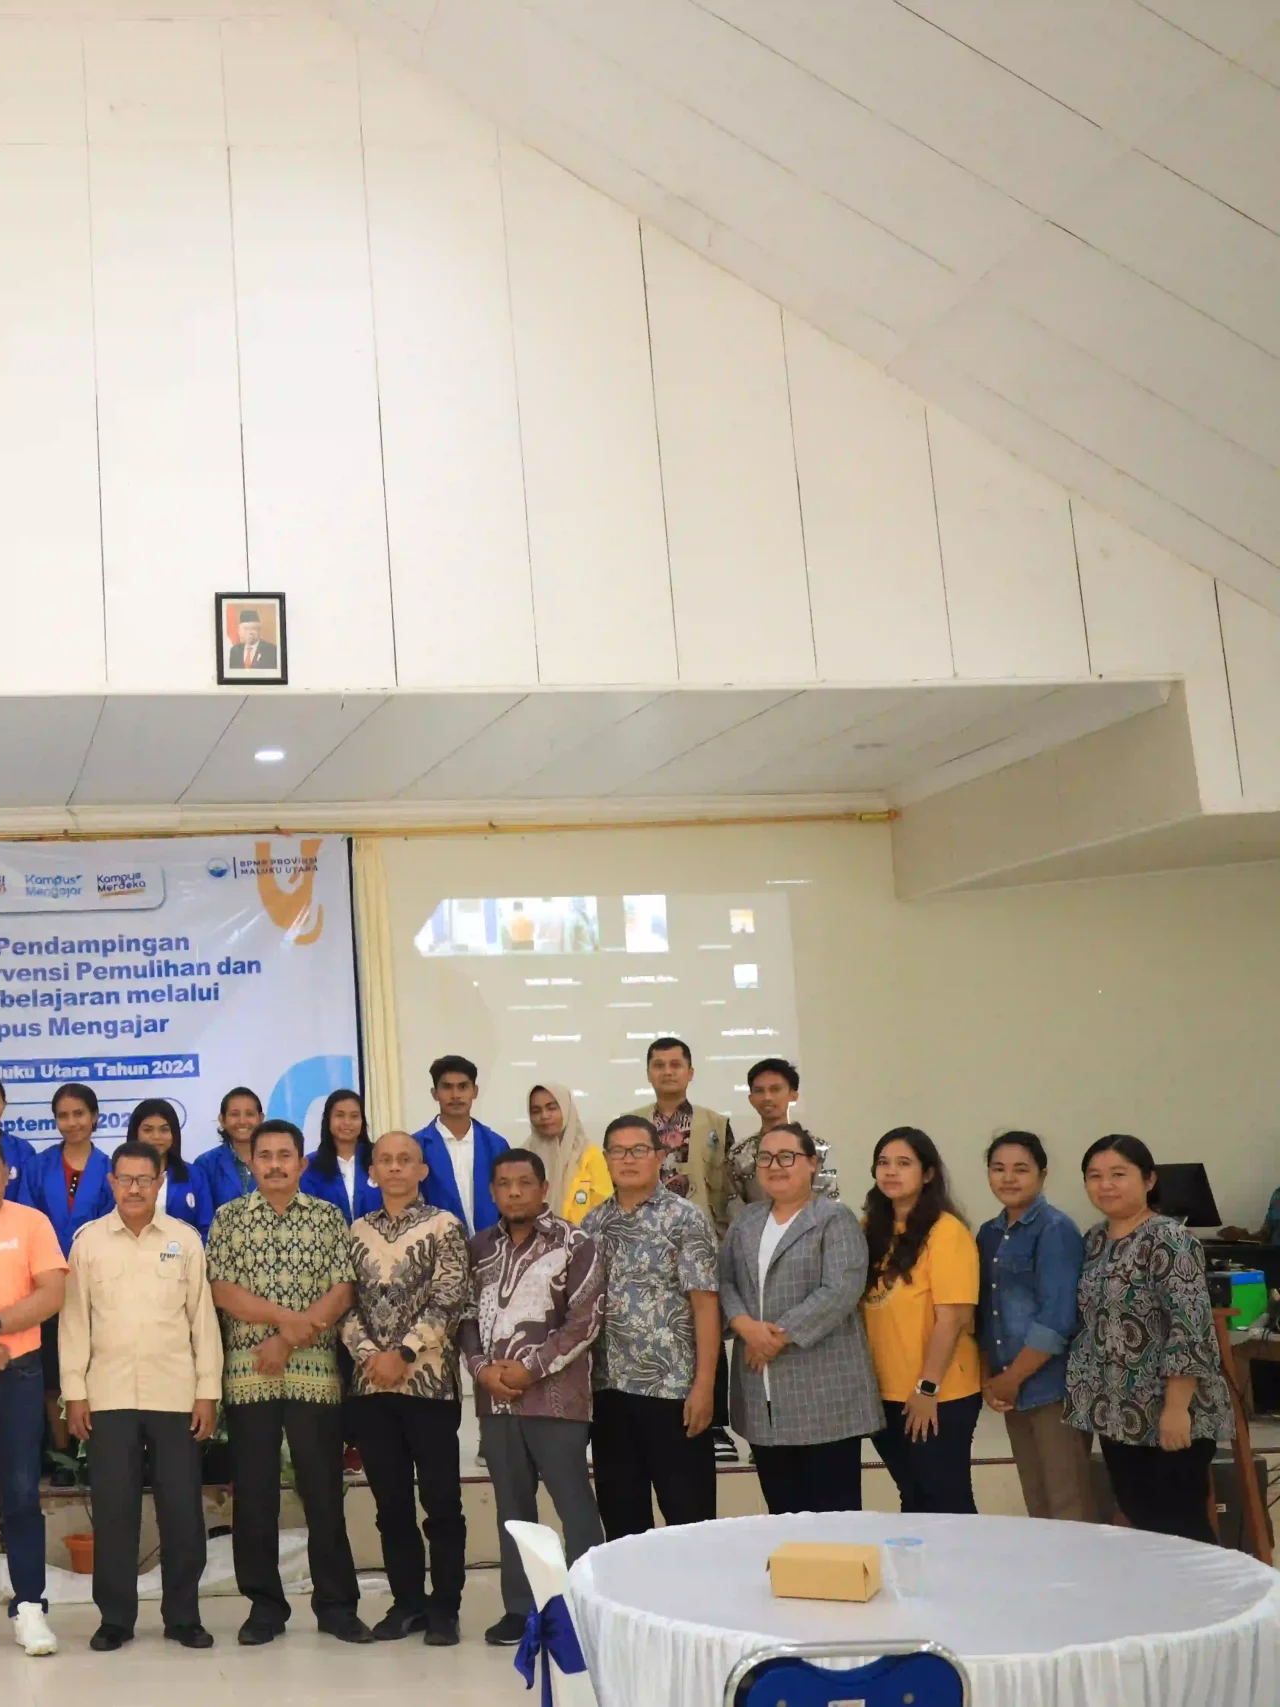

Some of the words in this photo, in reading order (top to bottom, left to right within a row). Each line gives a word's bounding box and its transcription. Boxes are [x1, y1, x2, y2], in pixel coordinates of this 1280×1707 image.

[271, 856, 318, 866] PROVINSI
[240, 866, 282, 875] MALUKU
[285, 864, 319, 874] UTARA
[24, 874, 77, 886] Kampus
[96, 872, 142, 885] Kampus
[25, 886, 83, 899] Mengajar
[97, 880, 147, 893] Merdeka
[76, 959, 211, 981] Pemulihan
[216, 956, 262, 975] dan
[126, 982, 220, 1004] melalui
[48, 1014, 170, 1040] Mengajar
[40, 1063, 90, 1078] Utara
[94, 1061, 149, 1076] Tahun
[151, 1059, 195, 1075] 2024
[96, 1112, 131, 1129] 202
